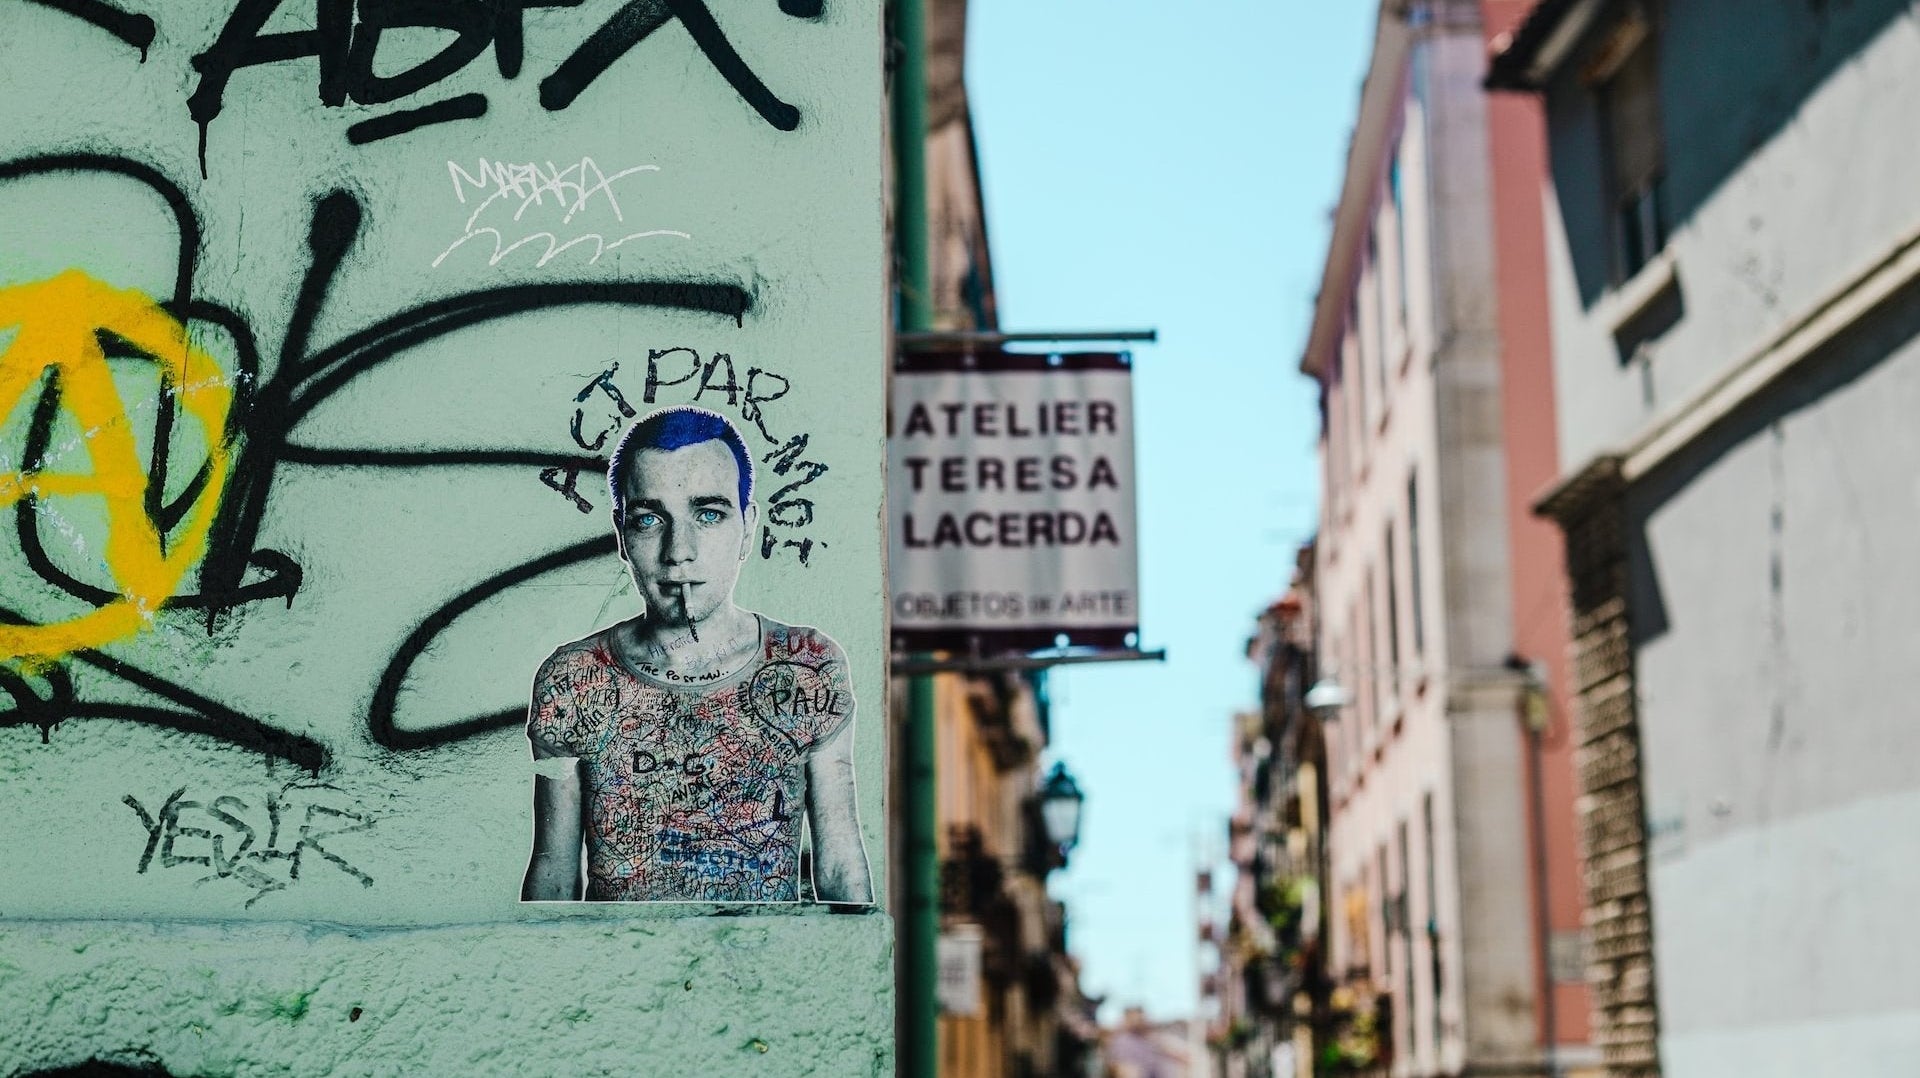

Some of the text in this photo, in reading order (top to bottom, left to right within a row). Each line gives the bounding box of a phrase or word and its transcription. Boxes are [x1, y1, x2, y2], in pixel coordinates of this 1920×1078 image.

[904, 401, 1118, 438] ATELIER
[904, 455, 1120, 493] TERESA
[903, 510, 1120, 549] LACERDA
[894, 591, 1025, 619] OBJETOS
[1057, 589, 1131, 616] ARTE
[765, 686, 843, 717] PAUL
